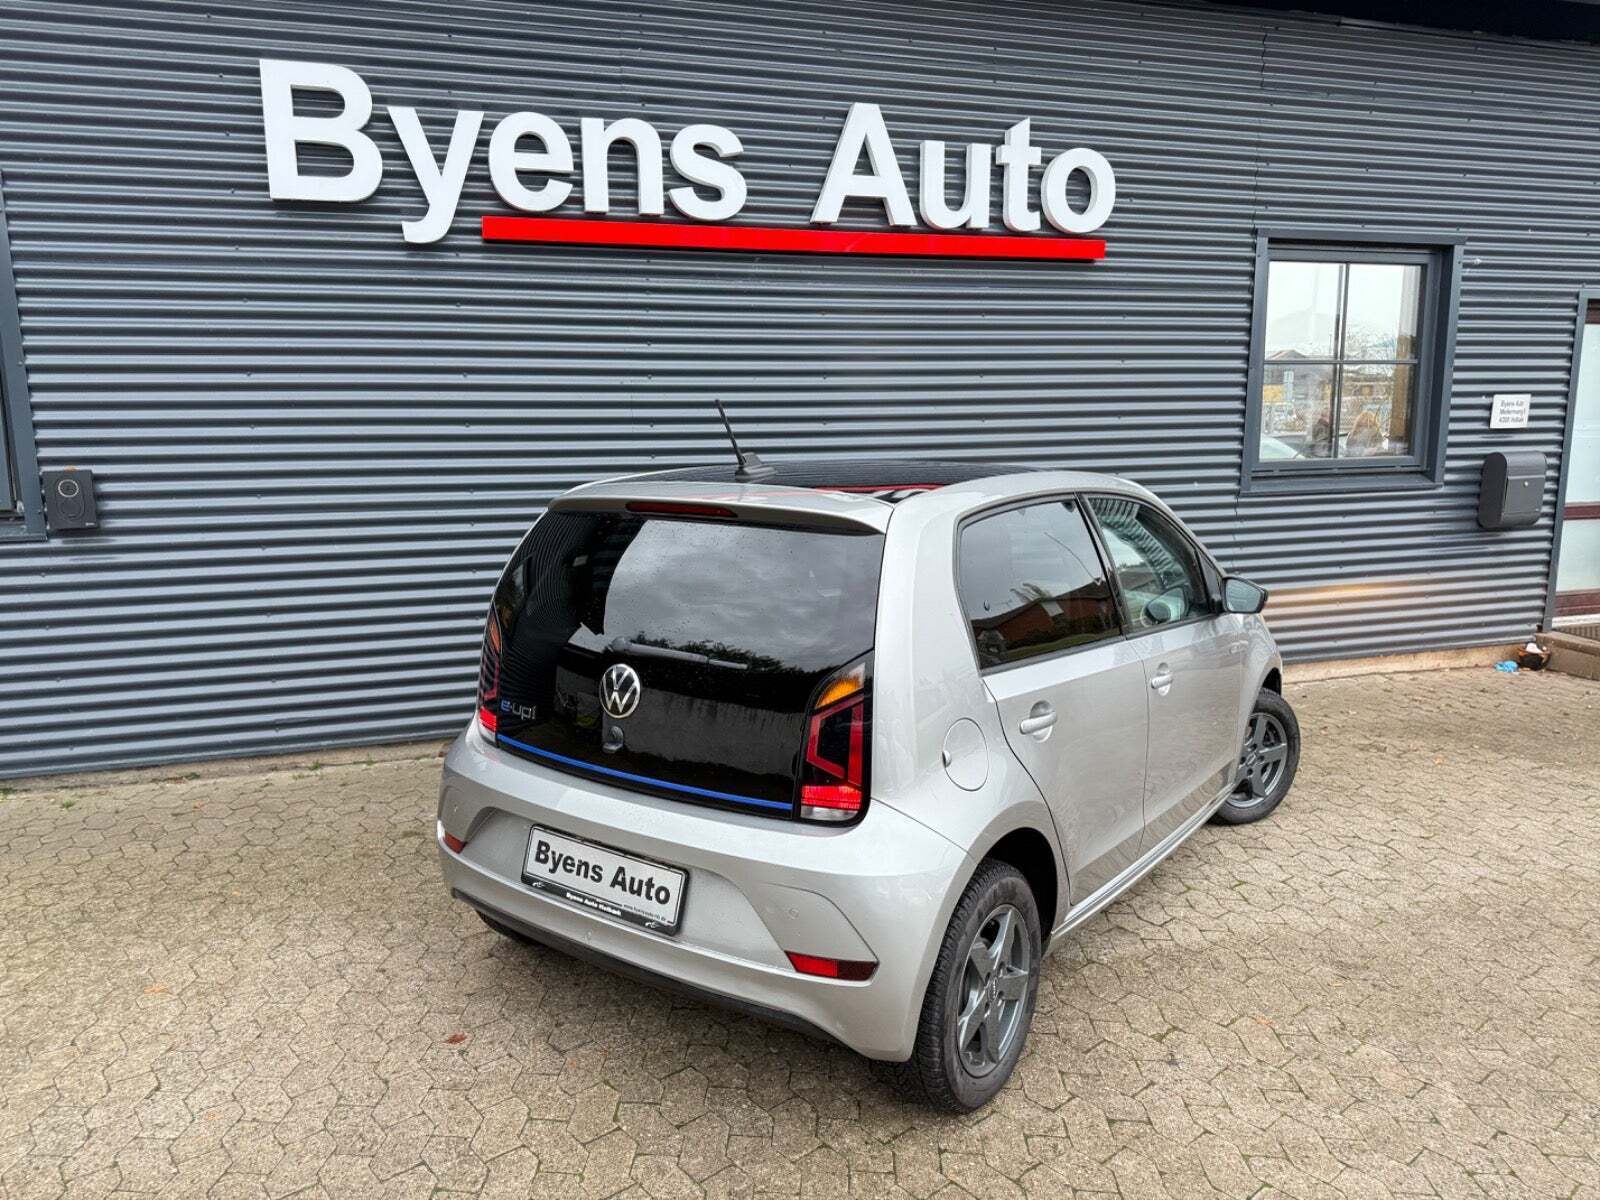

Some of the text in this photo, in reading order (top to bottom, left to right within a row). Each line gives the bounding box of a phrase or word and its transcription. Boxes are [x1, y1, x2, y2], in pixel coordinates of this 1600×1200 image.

[259, 59, 1117, 243] Byens Auto
[534, 839, 671, 905] Byens Auto
